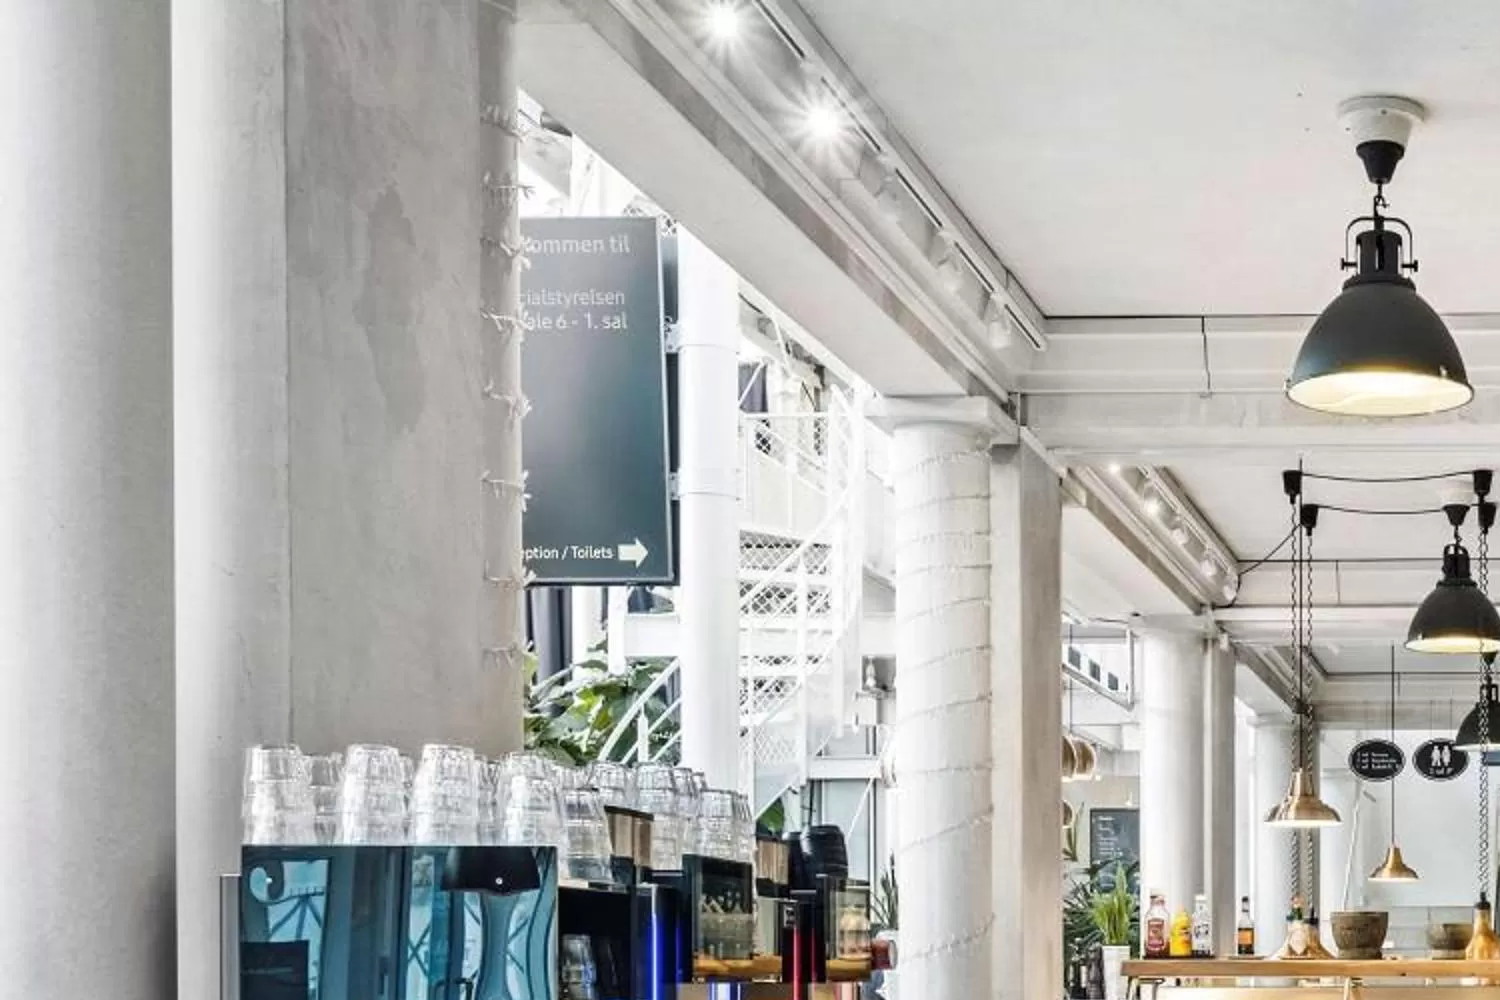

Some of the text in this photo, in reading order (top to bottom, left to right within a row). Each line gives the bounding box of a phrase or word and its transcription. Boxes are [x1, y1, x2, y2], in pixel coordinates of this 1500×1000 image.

[526, 234, 631, 254] ommen til
[602, 311, 628, 330] sal
[571, 546, 613, 559] Toilets
